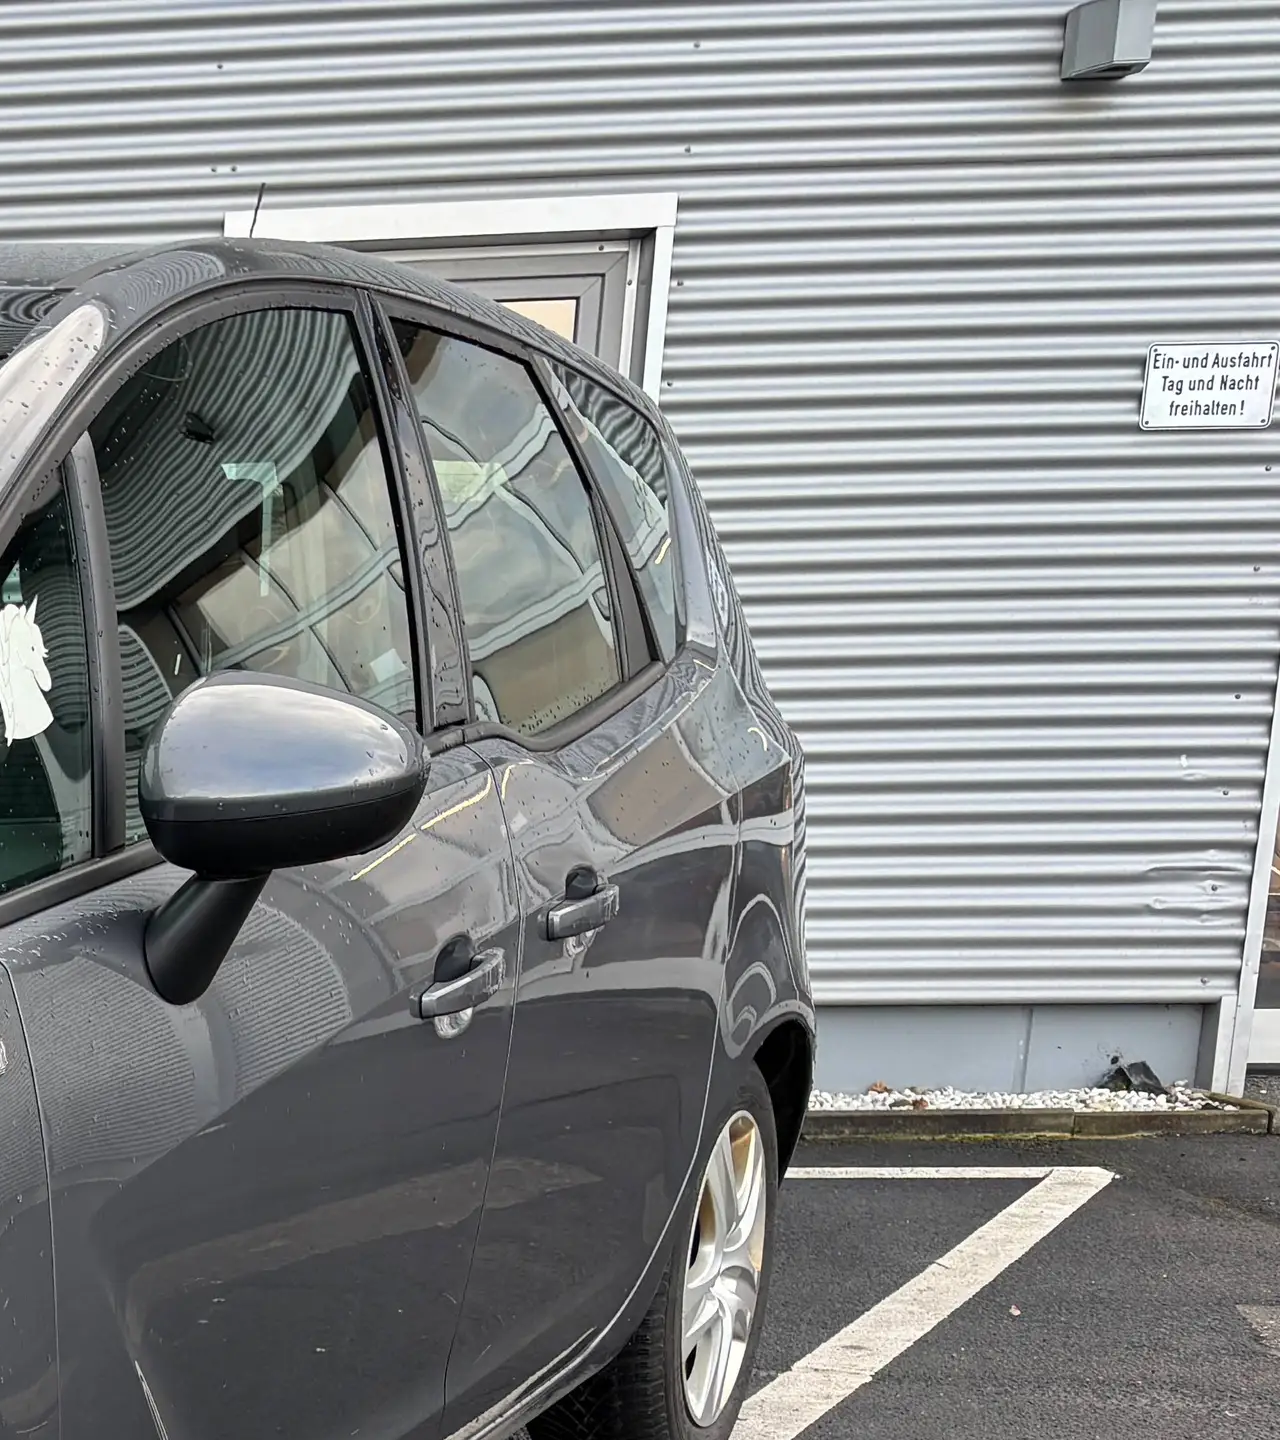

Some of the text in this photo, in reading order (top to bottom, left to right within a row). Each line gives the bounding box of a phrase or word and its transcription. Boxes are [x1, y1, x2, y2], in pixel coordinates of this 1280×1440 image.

[1153, 351, 1274, 369] Ein- und Ausfahrt
[1161, 375, 1260, 395] Tag und Nacht
